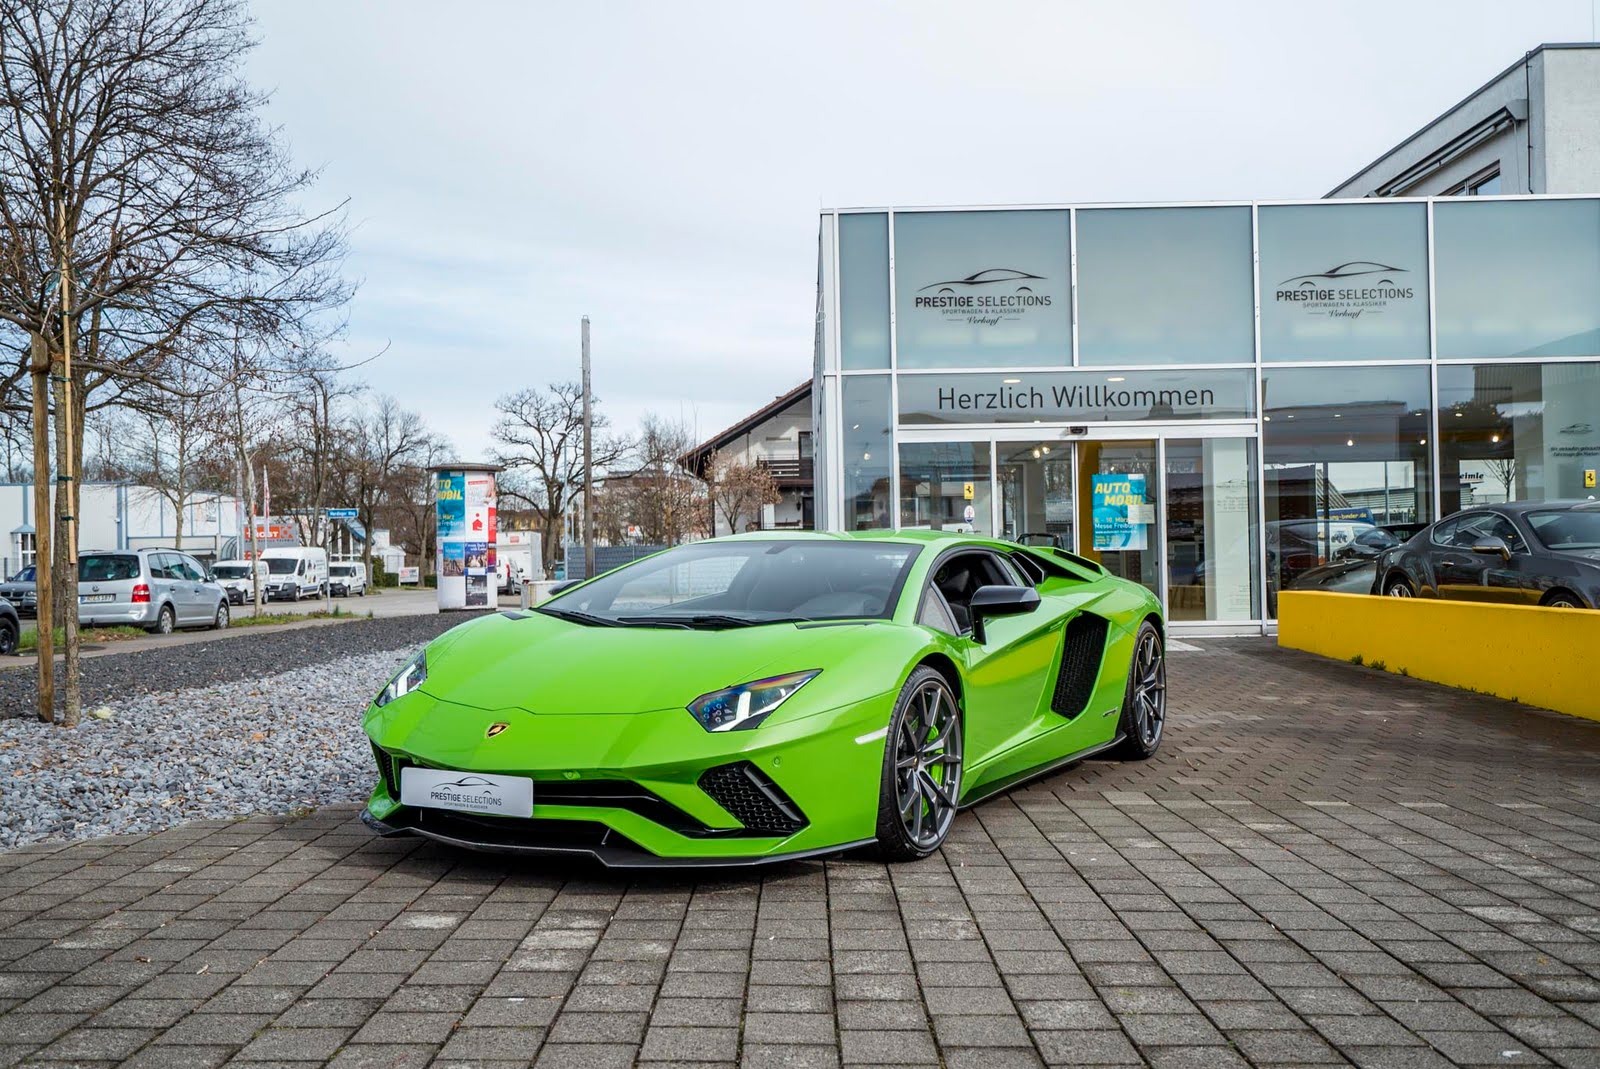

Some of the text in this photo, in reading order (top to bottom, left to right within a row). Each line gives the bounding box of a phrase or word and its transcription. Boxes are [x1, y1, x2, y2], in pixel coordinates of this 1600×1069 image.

[1276, 287, 1414, 301] PRESTIGE SELECTIONS
[915, 295, 1052, 307] PRESTIGE SELECTIONS
[1328, 308, 1364, 318] Verkauf
[966, 315, 1002, 325] Verkauf
[938, 384, 1214, 410] Herzlich Willkommen
[1094, 482, 1131, 494] AUTO
[1104, 494, 1144, 506] MOBIL
[1113, 522, 1137, 530] Freiburg
[430, 792, 502, 806] PRESTIGE SELECTIONS
